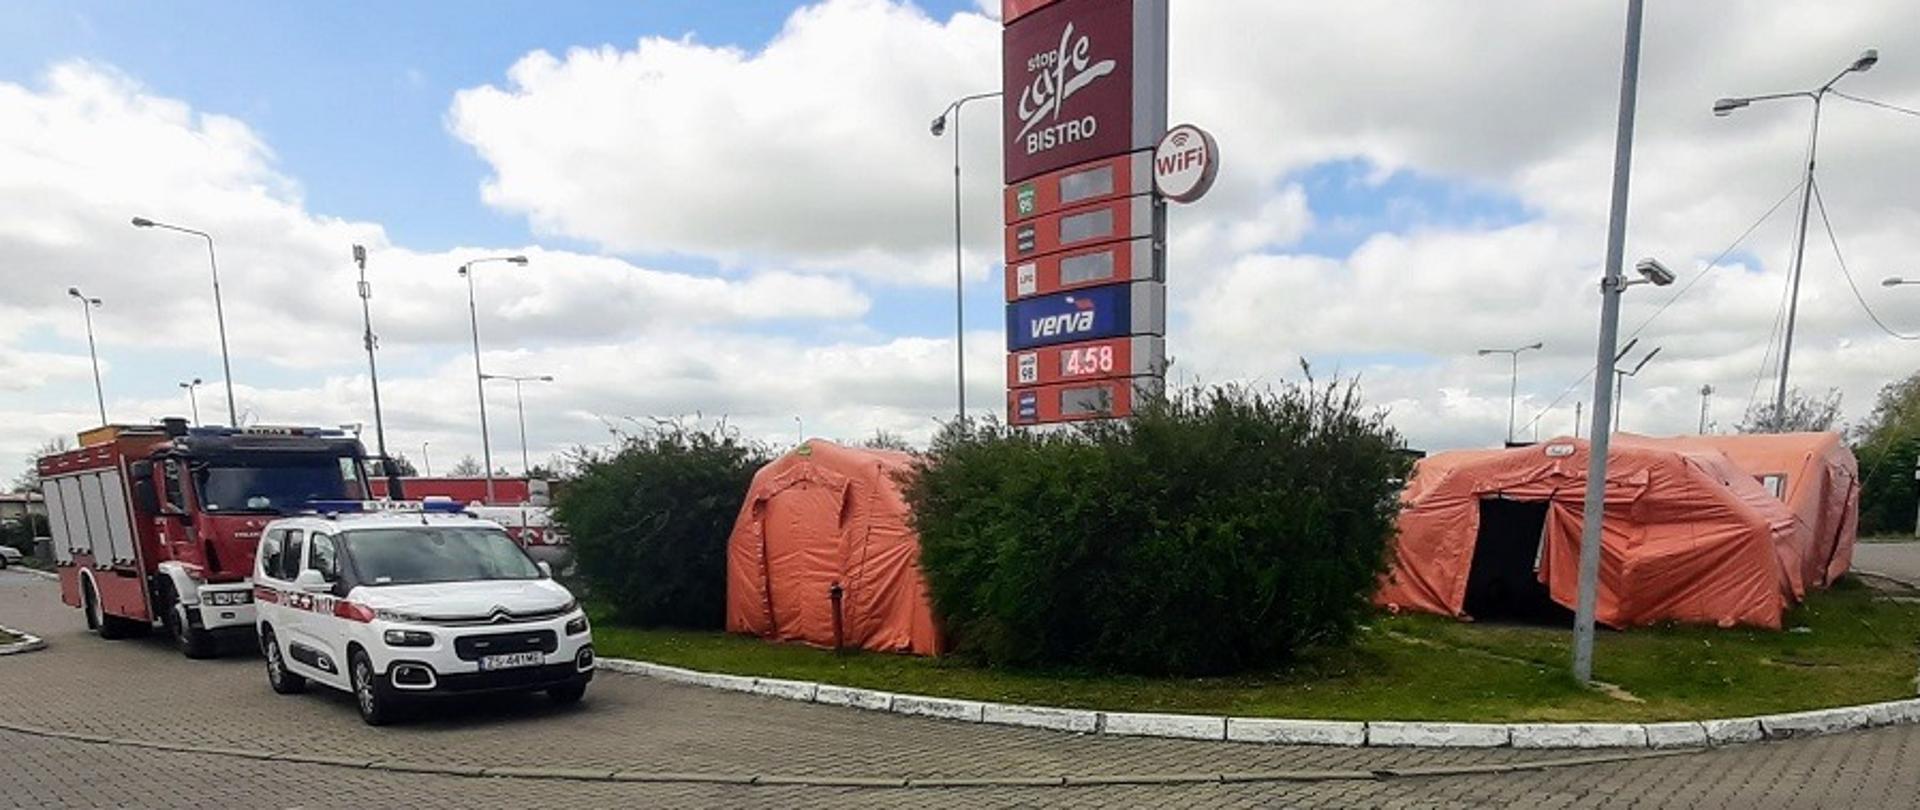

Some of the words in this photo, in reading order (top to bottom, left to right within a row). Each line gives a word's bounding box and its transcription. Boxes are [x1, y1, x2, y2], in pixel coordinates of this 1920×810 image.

[1028, 49, 1058, 72] stop
[1027, 115, 1096, 154] BISTRO
[1157, 146, 1203, 177] WiFi
[1019, 198, 1033, 213] 95
[1031, 311, 1095, 339] verva
[1066, 346, 1113, 375] 4.58
